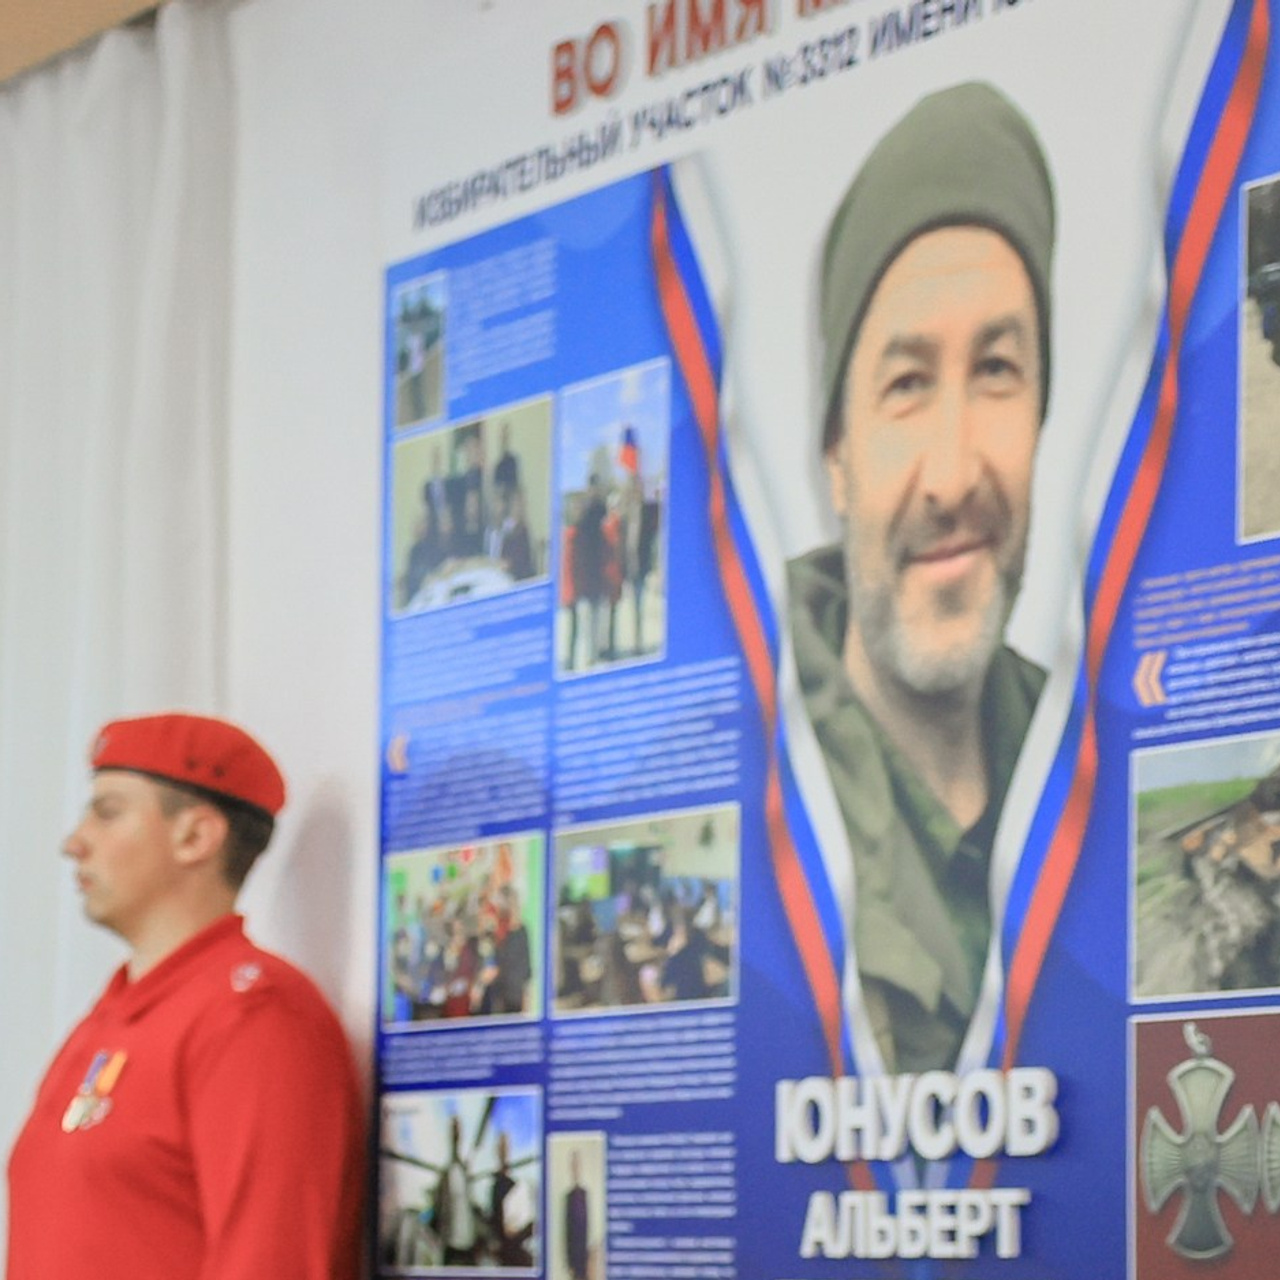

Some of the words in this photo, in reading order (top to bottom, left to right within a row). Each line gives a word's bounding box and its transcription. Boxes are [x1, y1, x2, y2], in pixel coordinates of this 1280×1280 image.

[551, 22, 621, 118] ВО
[646, 0, 768, 79] ИМЯ
[412, 112, 624, 229] ИЗБИРАТЕЛЬНЫЙ
[629, 66, 757, 149] УЧАСТОК
[775, 1067, 1058, 1163] ЮНУСОВ
[800, 1187, 1031, 1259] АЛЬБЕРТ
